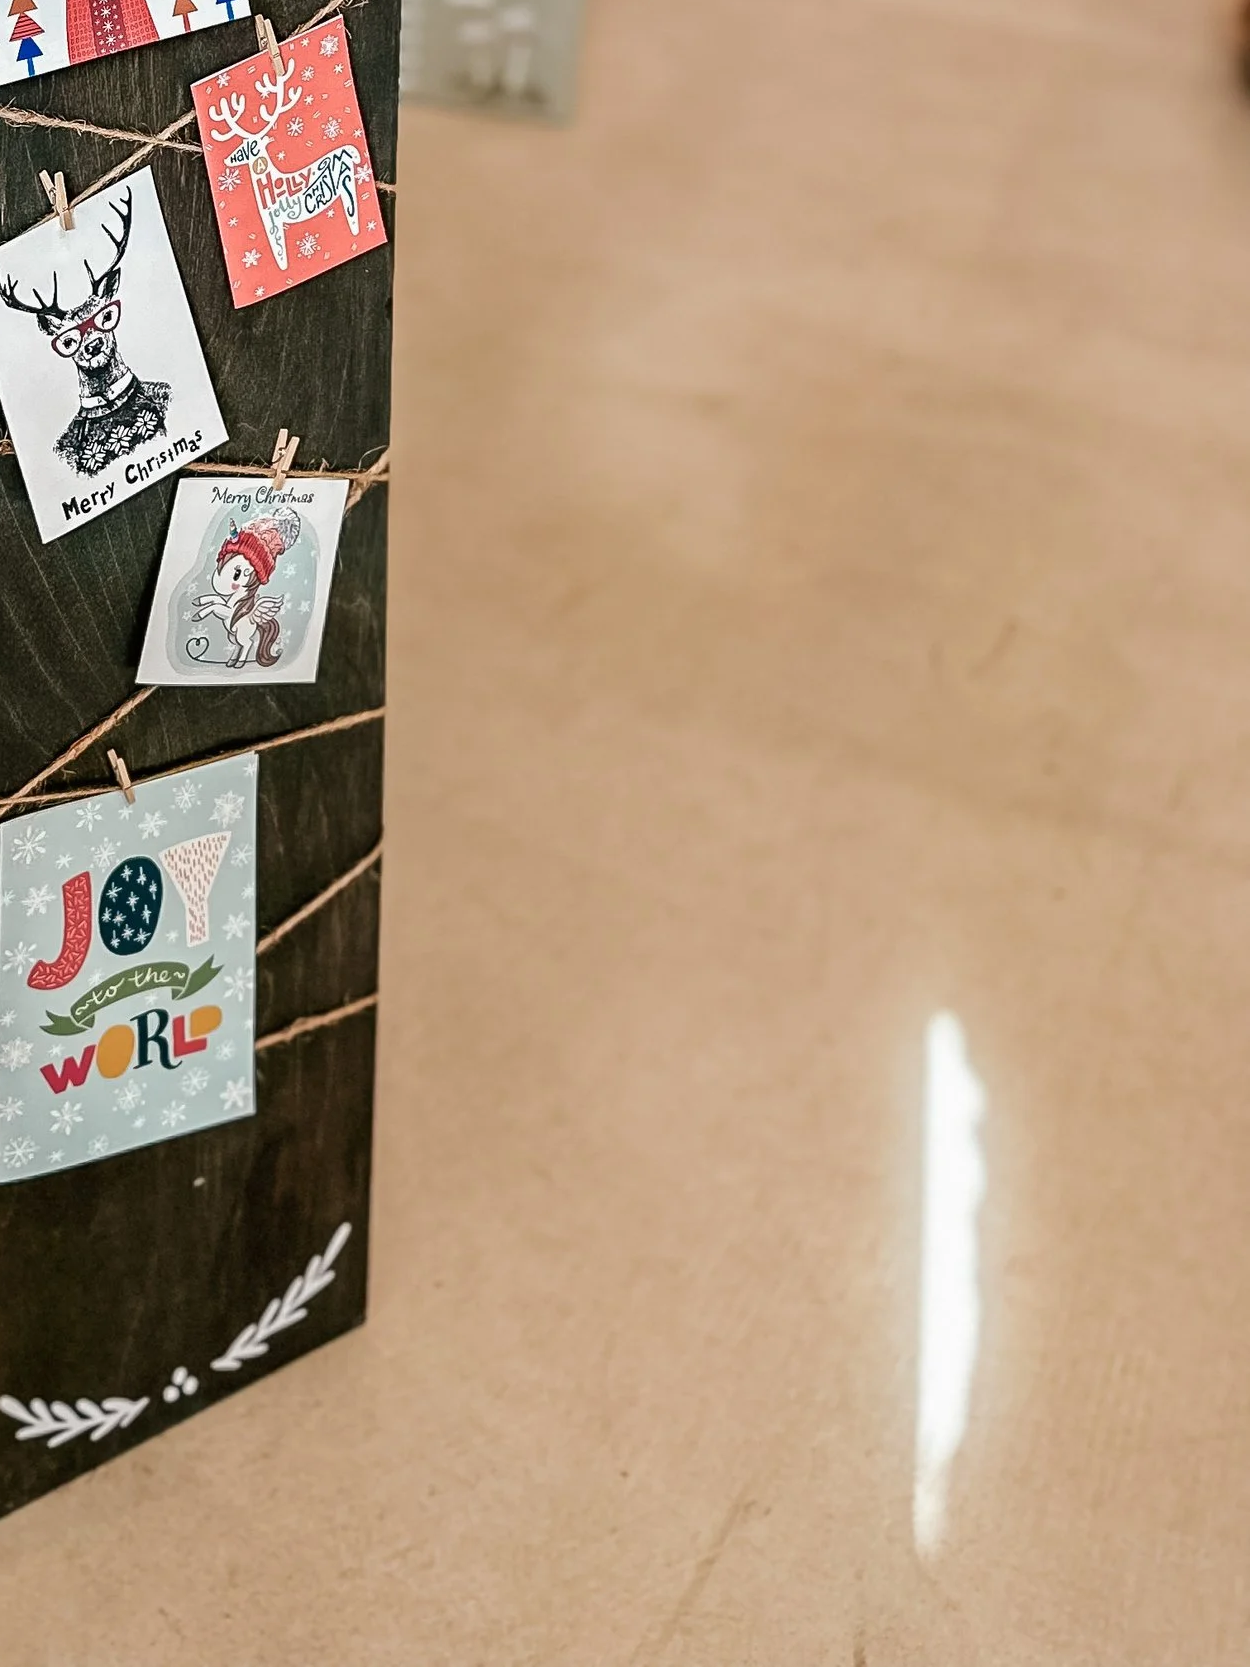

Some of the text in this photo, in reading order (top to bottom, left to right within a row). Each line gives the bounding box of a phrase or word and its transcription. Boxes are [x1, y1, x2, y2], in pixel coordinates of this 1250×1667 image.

[267, 195, 302, 235] jolly
[61, 429, 204, 521] Merry Christmas
[211, 486, 315, 512] Merry Christmas
[27, 831, 232, 990] JOY
[91, 967, 172, 1005] to the
[39, 1005, 223, 1095] WORLD
